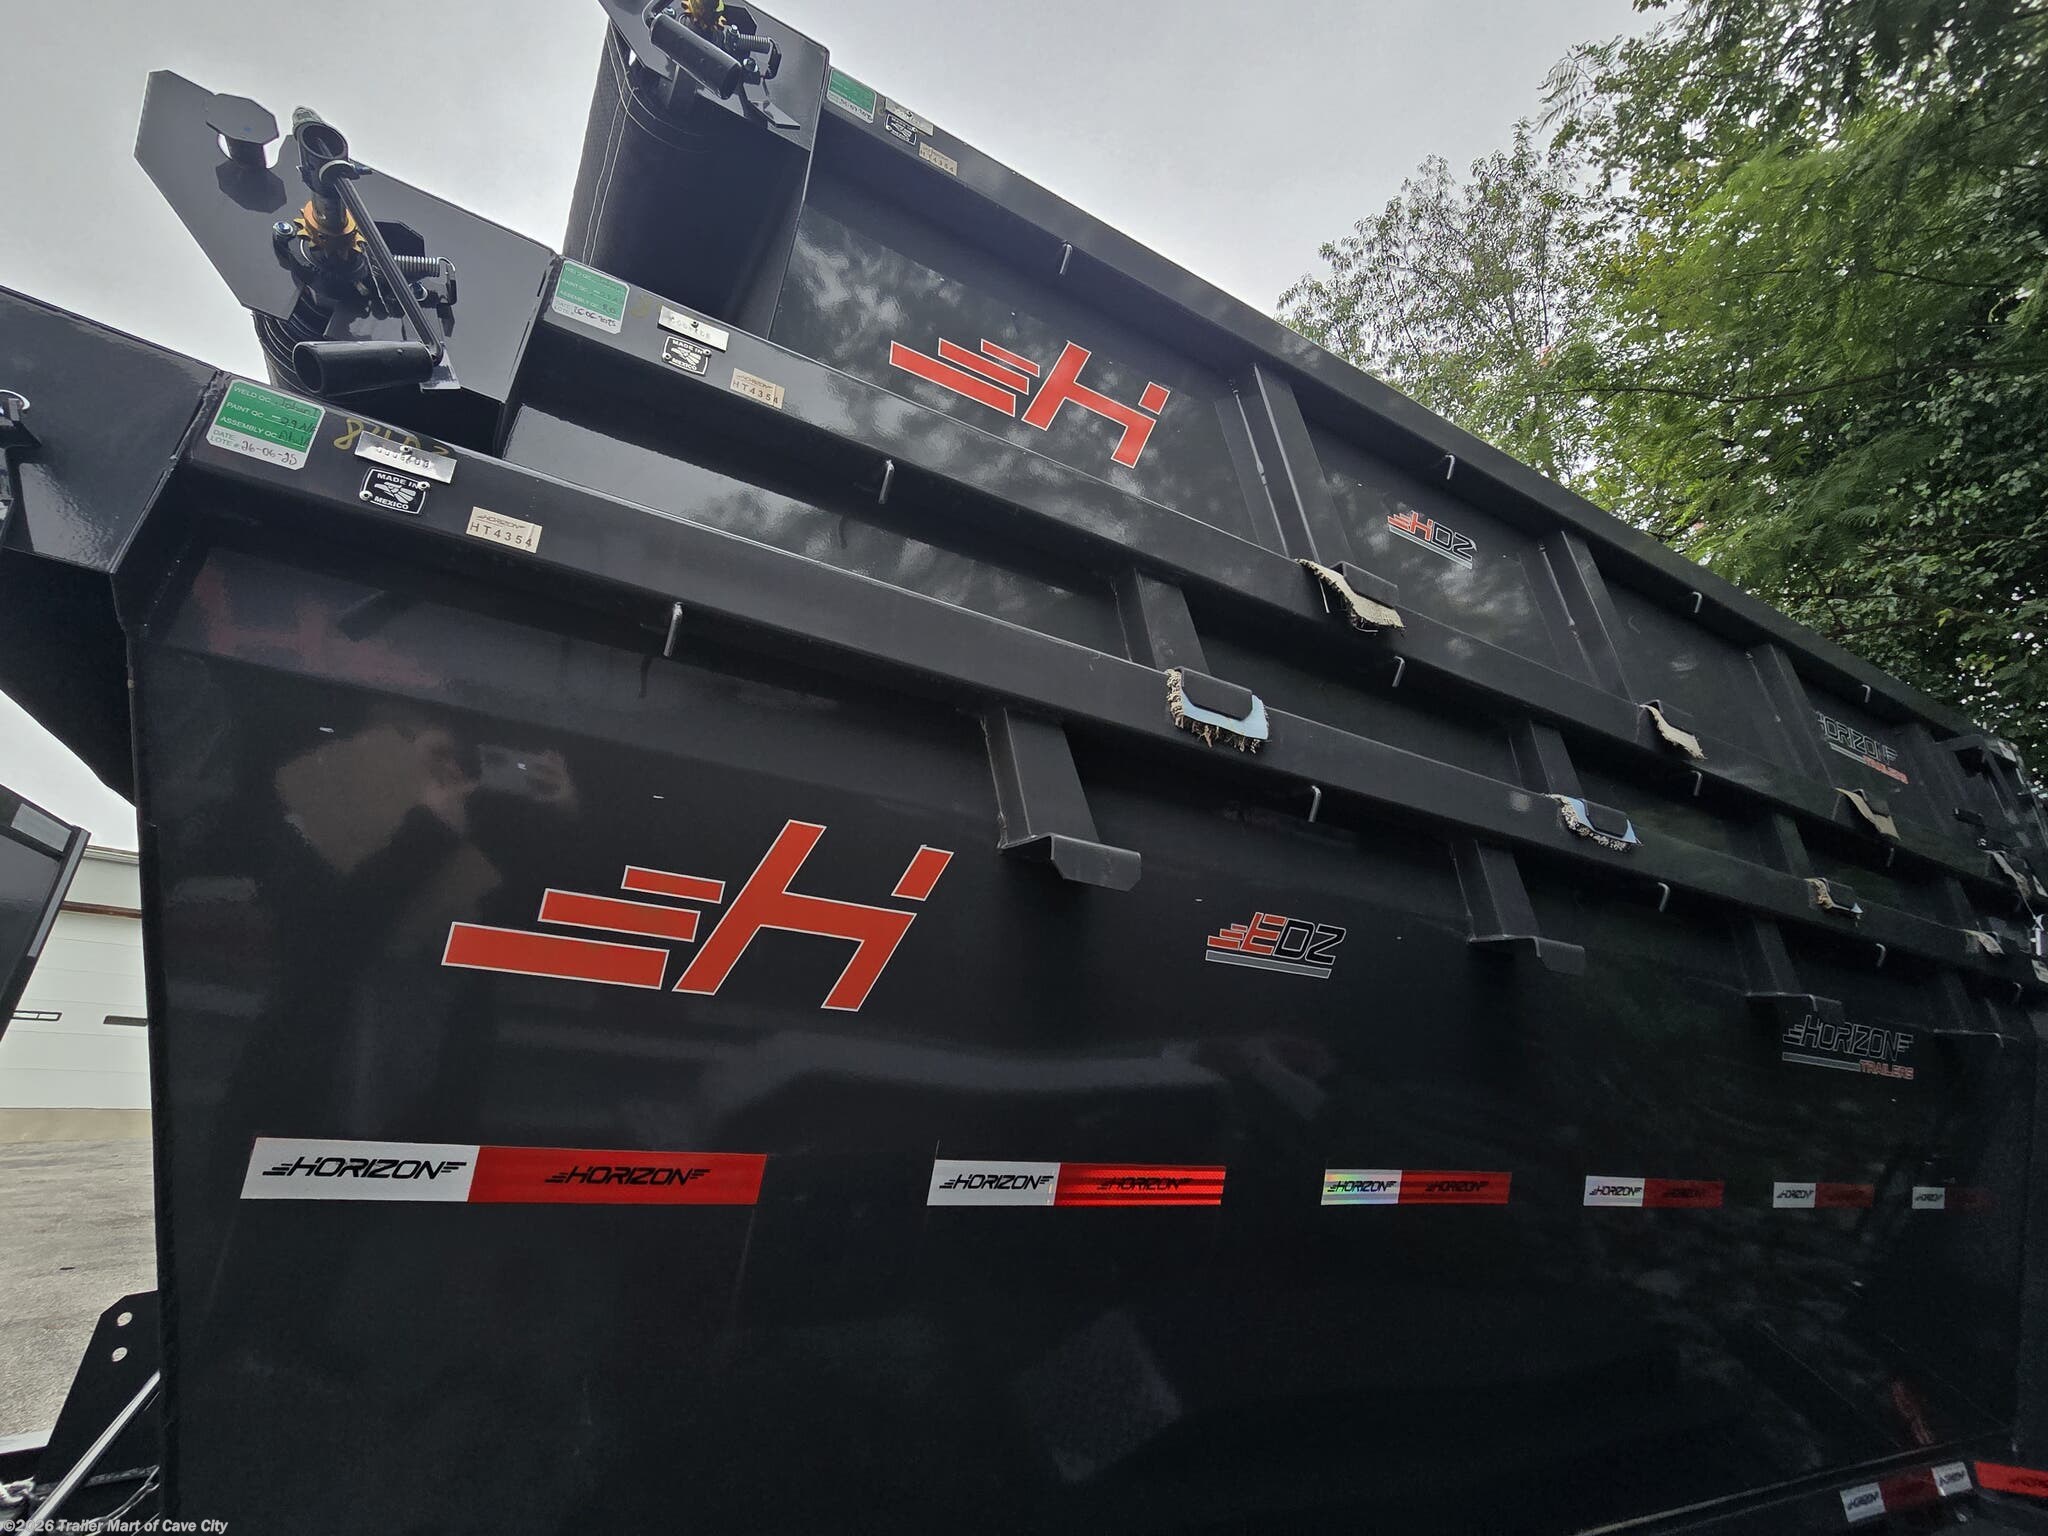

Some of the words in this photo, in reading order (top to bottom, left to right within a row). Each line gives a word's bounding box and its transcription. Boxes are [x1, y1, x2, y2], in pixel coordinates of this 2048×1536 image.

[234, 386, 257, 398] WELD
[258, 394, 271, 403] QC
[226, 402, 250, 413] PAINT
[251, 410, 265, 418] QC
[221, 416, 264, 434] ASSEMBLY
[264, 430, 277, 438] QC
[377, 472, 407, 486] MADE
[408, 482, 420, 490] IN
[374, 495, 410, 510] MEXICO
[1793, 1014, 1904, 1062] HORIZON
[1859, 1059, 1914, 1080] TRAILERS
[277, 1156, 455, 1180] HORIZON
[558, 1165, 700, 1186] HORIZON
[947, 1174, 1048, 1190] HORIZON
[1332, 1180, 1393, 1192] HORIZON
